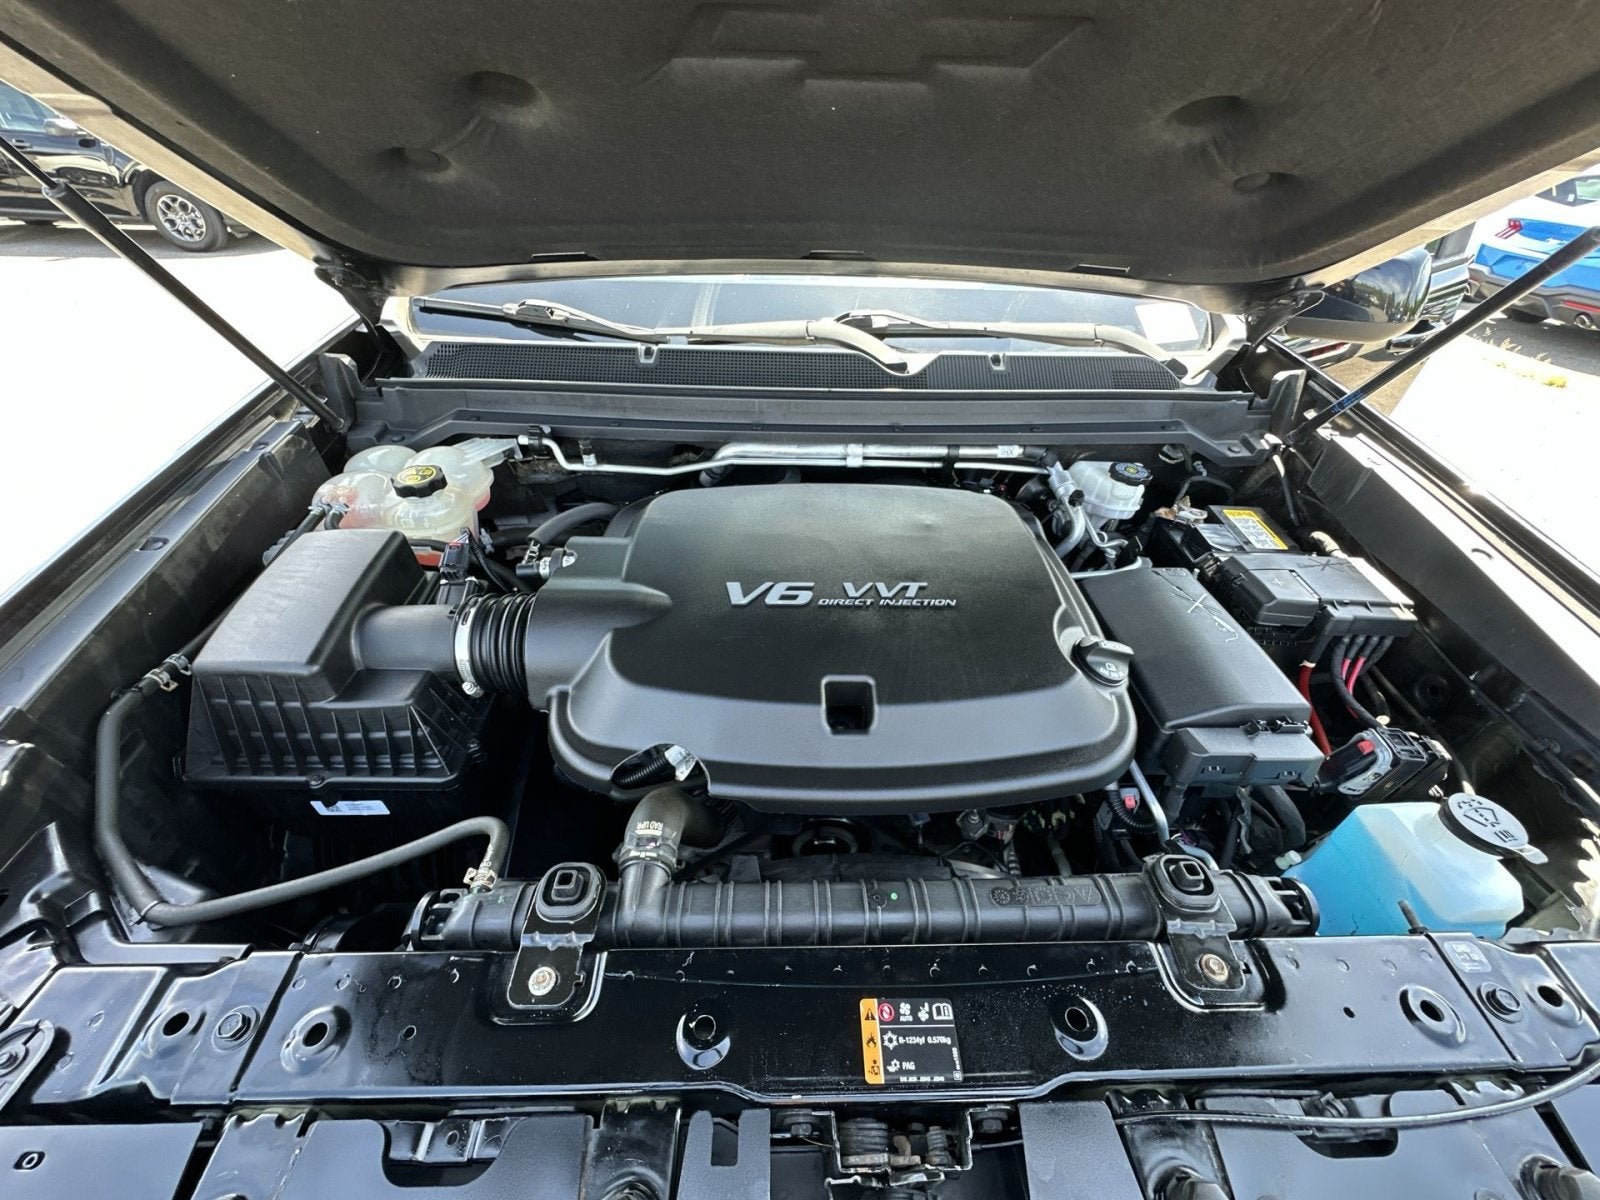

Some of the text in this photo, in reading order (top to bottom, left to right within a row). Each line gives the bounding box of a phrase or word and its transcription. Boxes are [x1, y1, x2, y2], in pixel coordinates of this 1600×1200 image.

[725, 581, 928, 606] V6 VVT
[817, 598, 957, 607] DIRECT INJECTION
[901, 1061, 916, 1071] PAG
